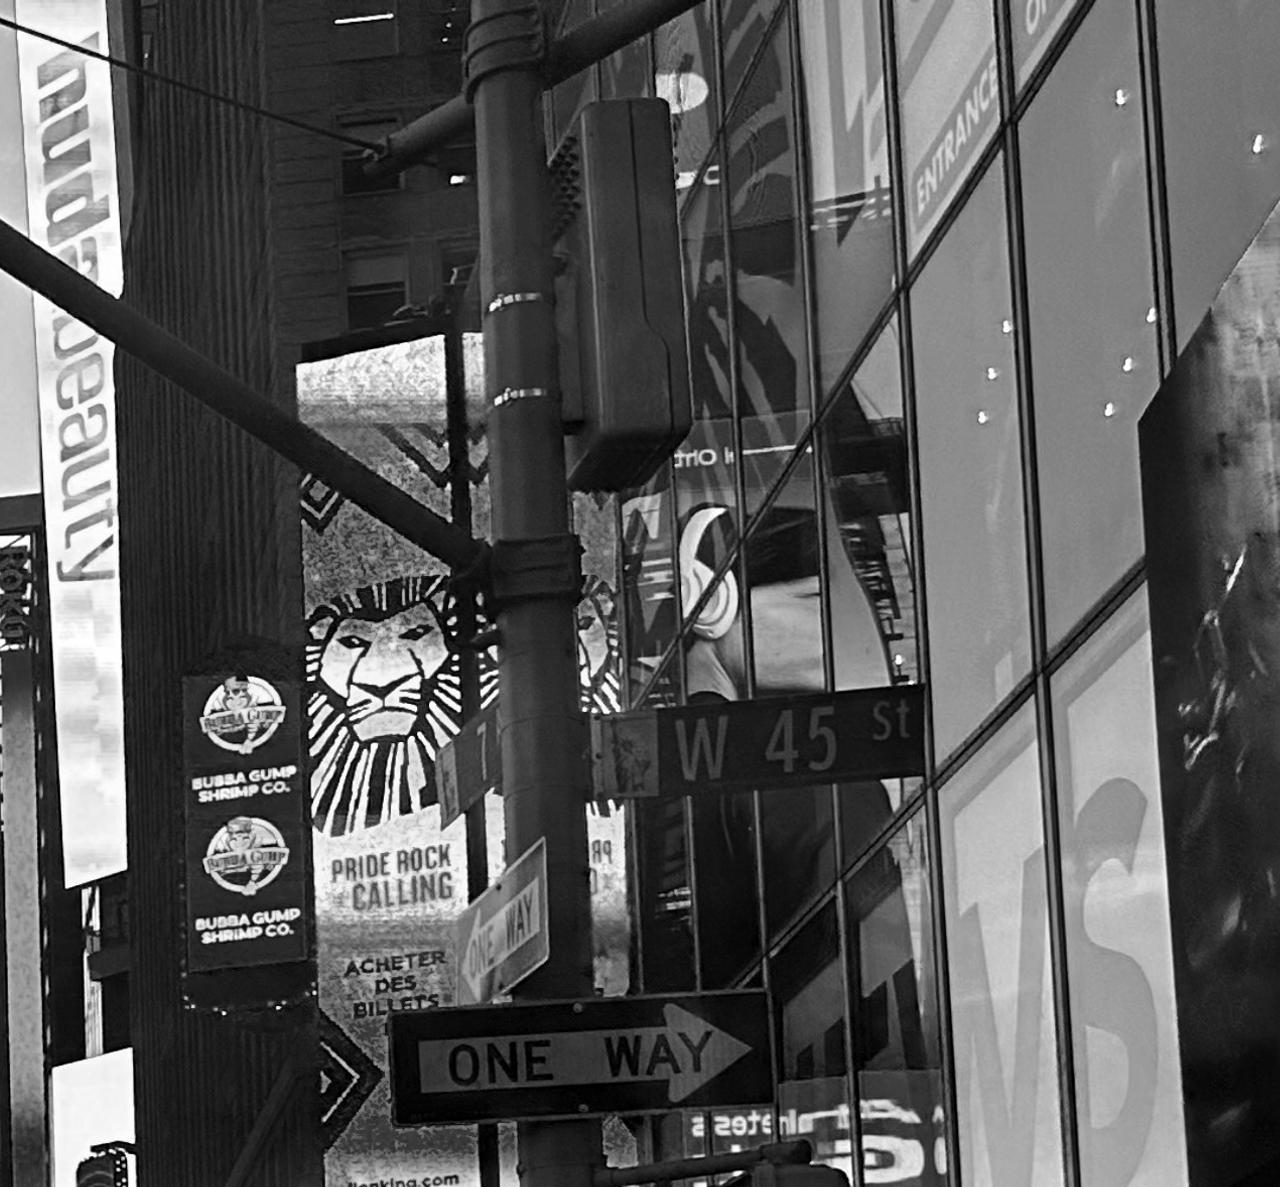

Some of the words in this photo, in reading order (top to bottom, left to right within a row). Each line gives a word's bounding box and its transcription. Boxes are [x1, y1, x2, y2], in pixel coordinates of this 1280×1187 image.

[916, 55, 999, 217] ENTRANCE
[674, 715, 729, 783] W
[764, 712, 839, 774] 45
[871, 697, 912, 742] St
[192, 773, 247, 790] BUBBA
[248, 764, 297, 784] GUMP
[261, 780, 290, 795] CO.
[331, 852, 390, 883] PRIDE
[395, 844, 452, 875] ROCK
[351, 872, 453, 911] CALLING
[252, 907, 301, 925] GUMP
[265, 922, 295, 938] CO.
[504, 887, 535, 950] WAY
[344, 952, 447, 977] ACHETER
[376, 976, 417, 996] DES
[447, 1038, 555, 1085] ONE
[604, 1026, 717, 1078] WAY
